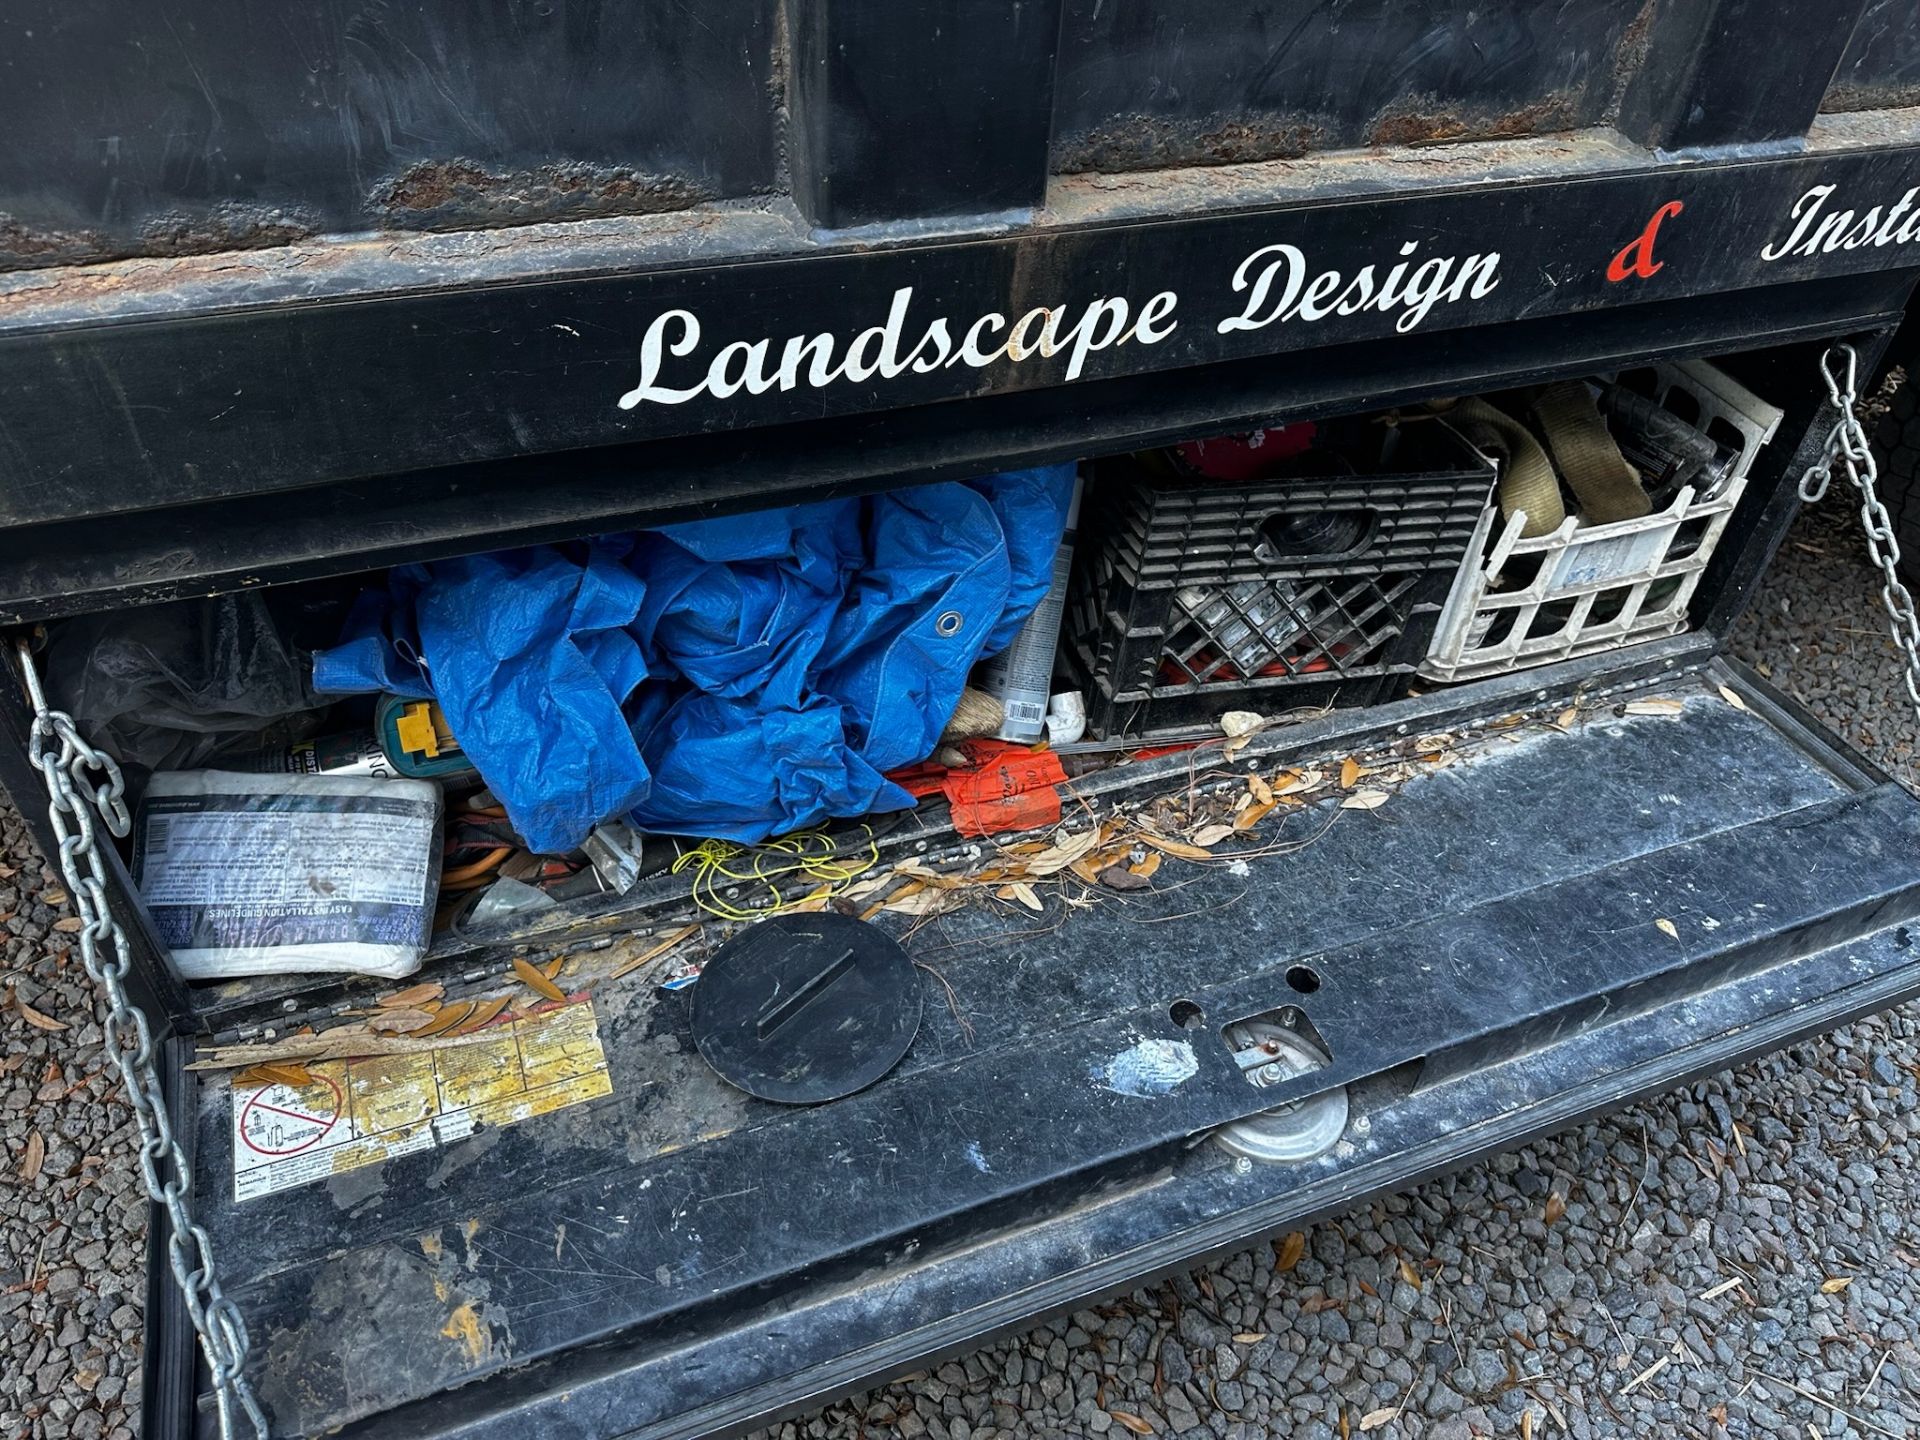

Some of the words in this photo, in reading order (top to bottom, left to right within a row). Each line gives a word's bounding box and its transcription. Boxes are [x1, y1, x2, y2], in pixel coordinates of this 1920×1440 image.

[618, 287, 1178, 411] Landscape
[1217, 242, 1501, 334] Design
[209, 906, 264, 918] GUIDELINES
[265, 904, 330, 917] INSTALLATION
[330, 903, 353, 914] EASY
